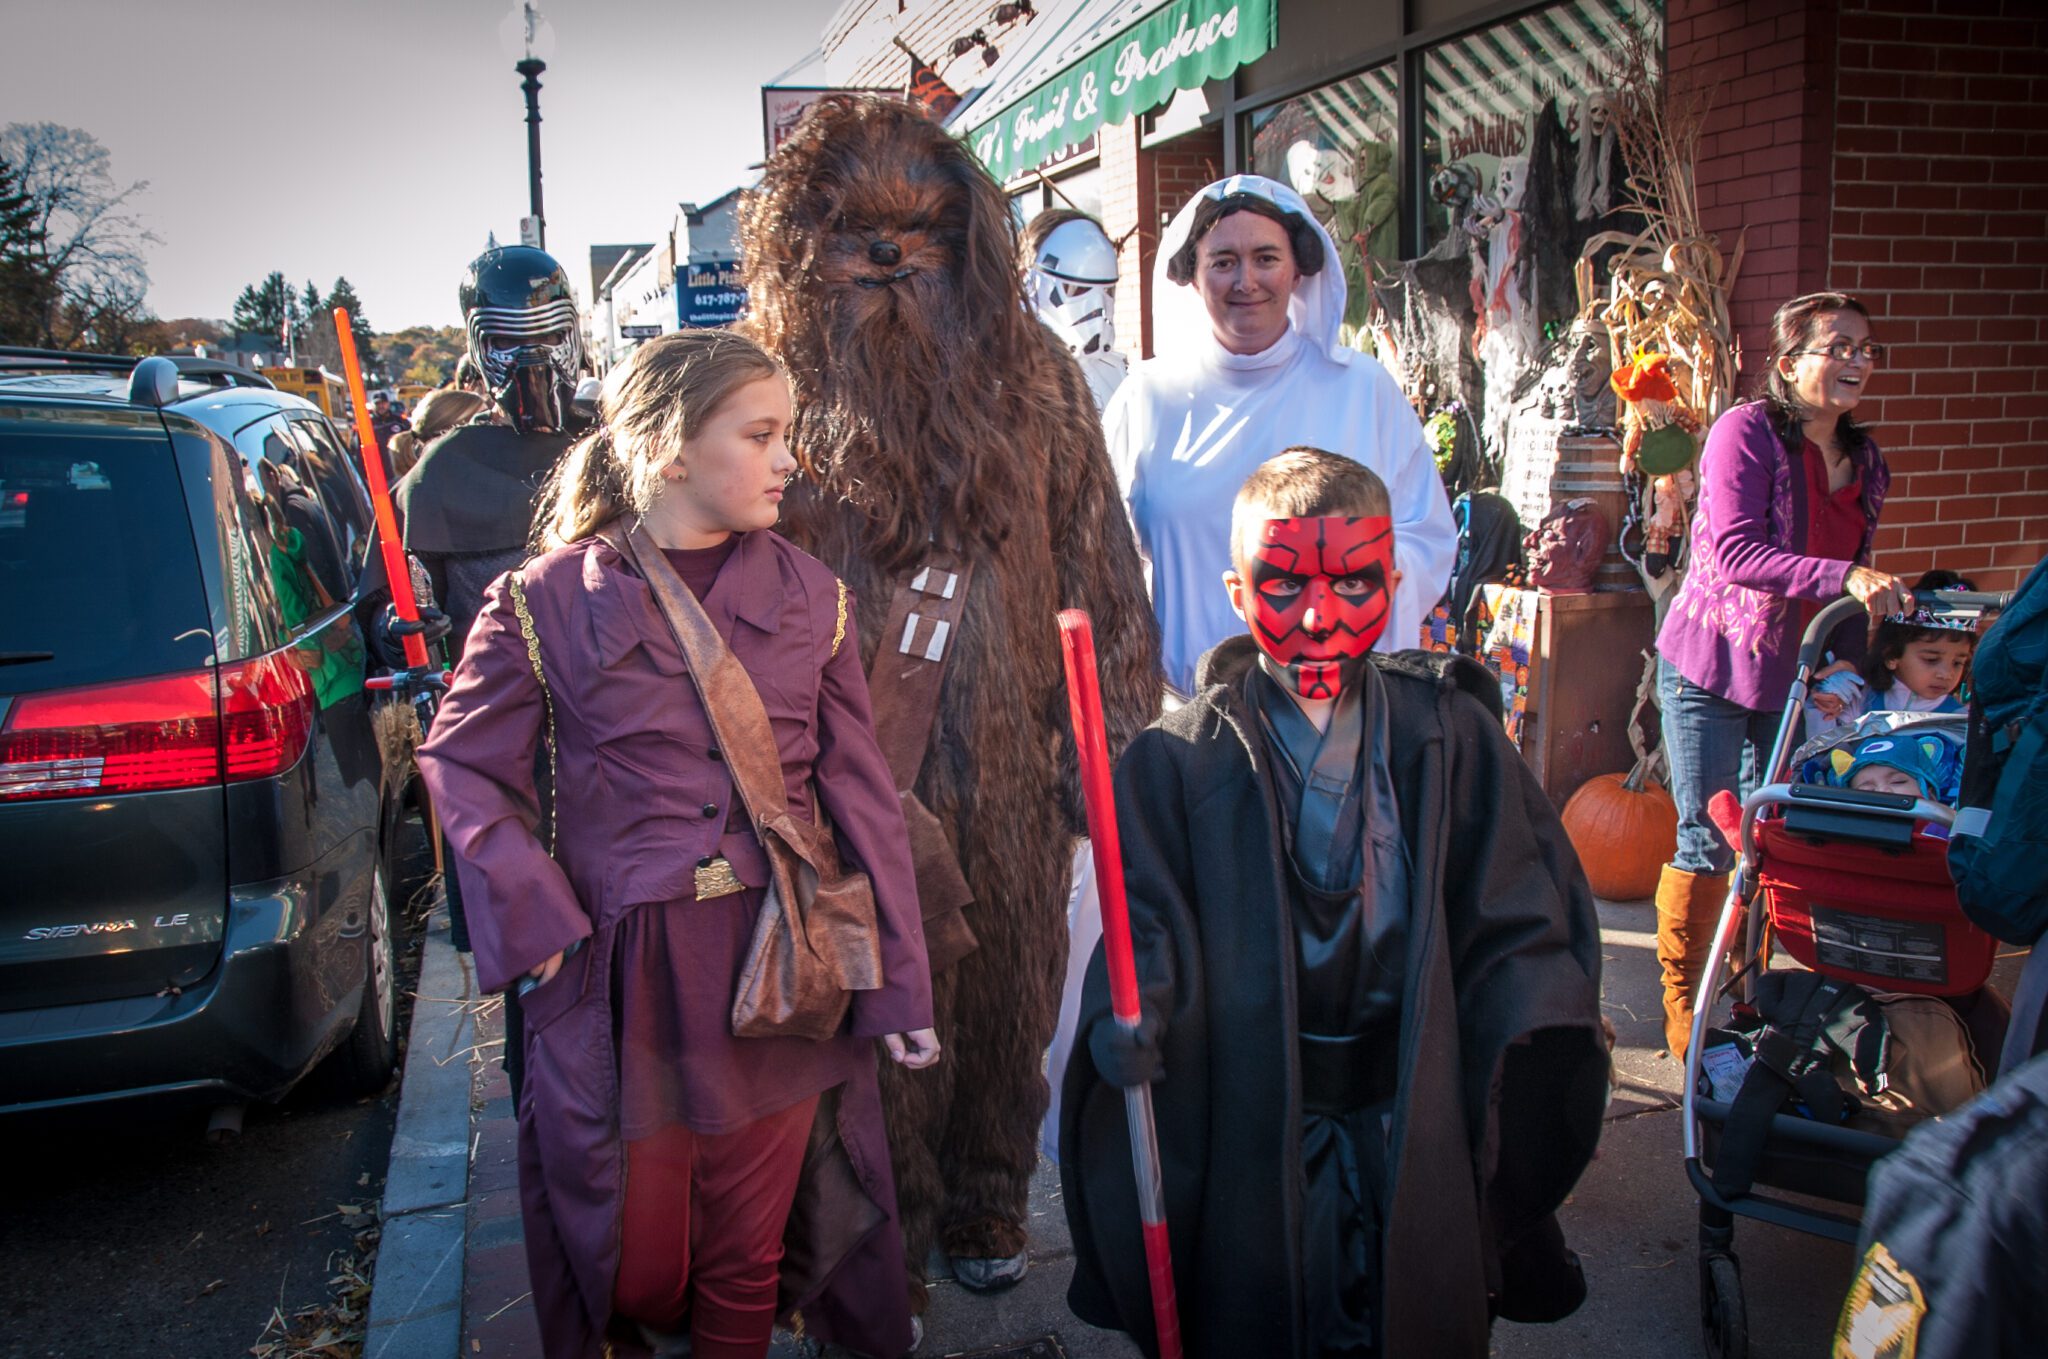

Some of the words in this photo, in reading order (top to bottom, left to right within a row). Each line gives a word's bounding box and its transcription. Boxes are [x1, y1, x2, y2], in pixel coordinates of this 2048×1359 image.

[1013, 85, 1070, 153] Fruit
[1073, 71, 1099, 121] &
[1110, 4, 1239, 96] Produce
[1447, 111, 1529, 164] BANANAS
[688, 271, 716, 287] Little
[695, 292, 748, 306] 617-787-7
[22, 919, 139, 940] SIENNA
[154, 913, 190, 928] LE
